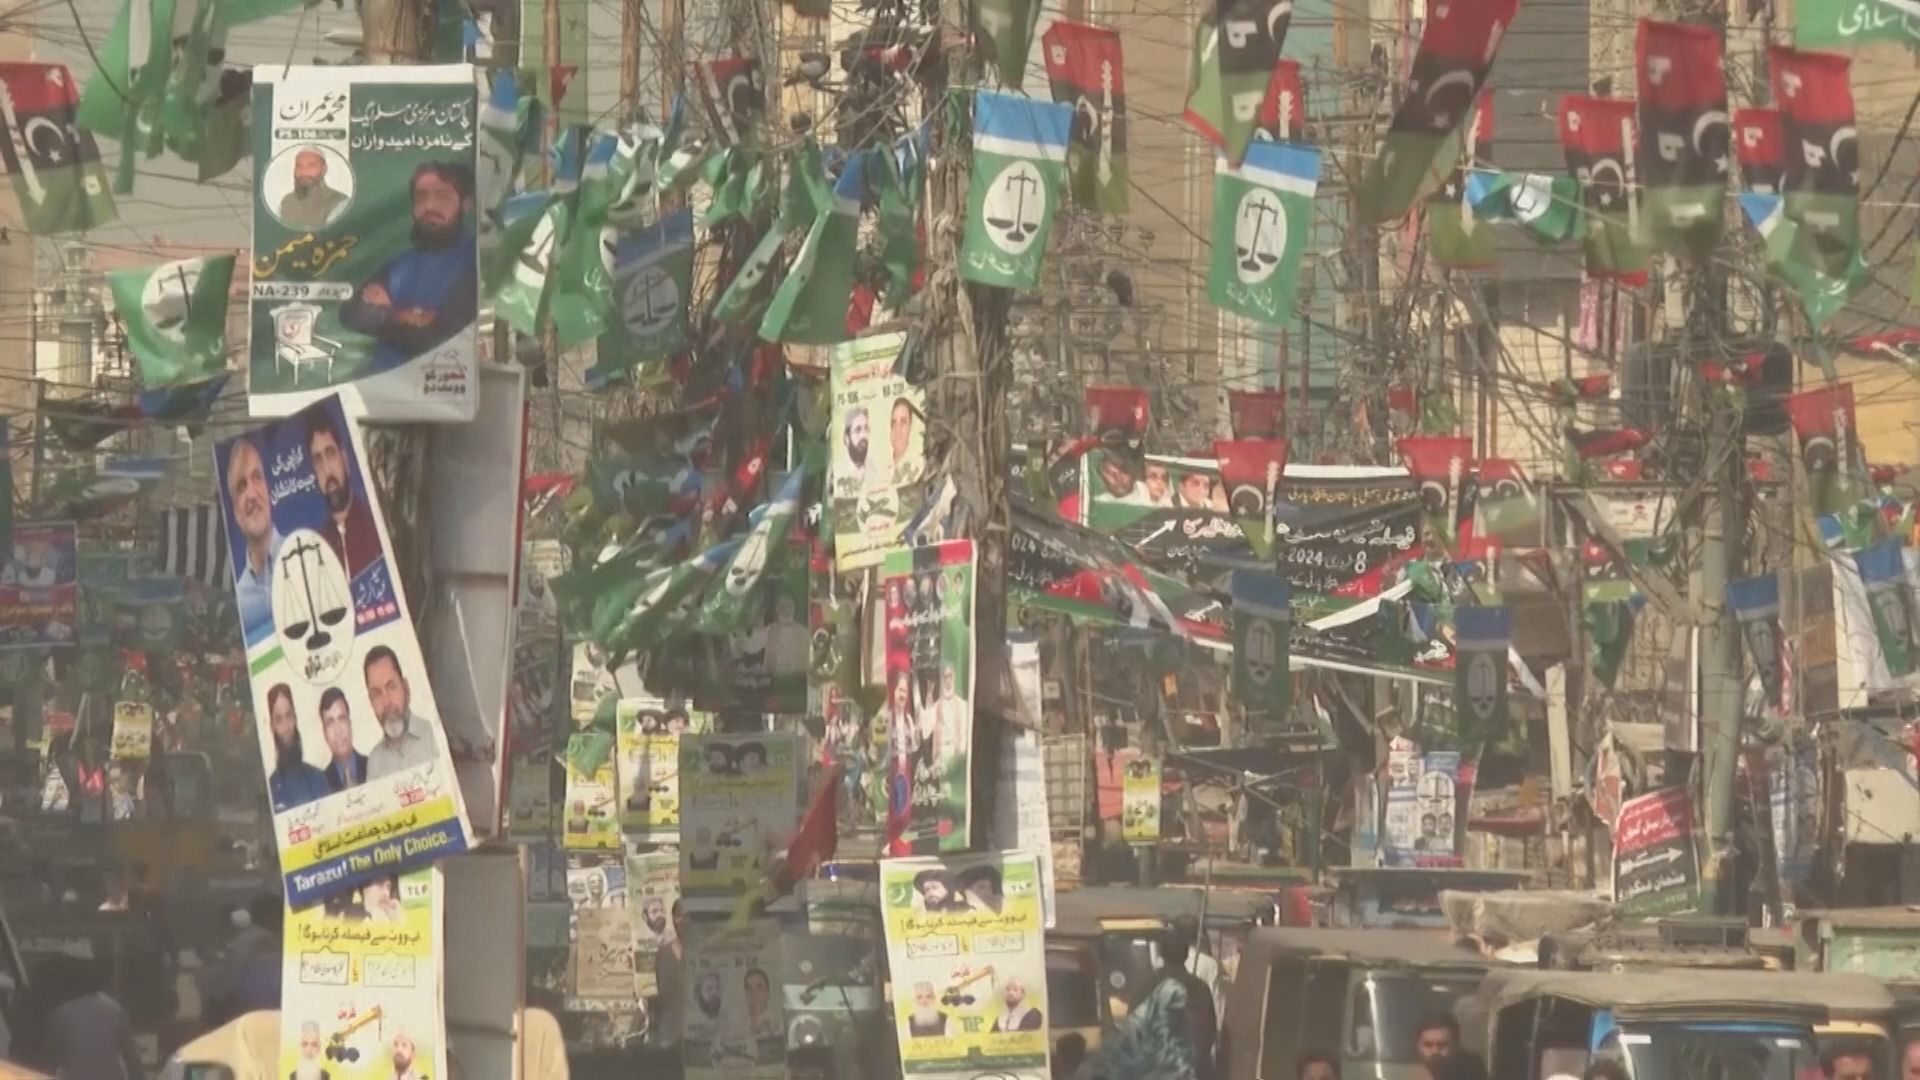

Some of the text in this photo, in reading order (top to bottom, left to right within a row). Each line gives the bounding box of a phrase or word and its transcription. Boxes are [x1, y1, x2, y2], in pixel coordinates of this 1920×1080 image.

[403, 100, 435, 126] مرکزی
[435, 97, 473, 128] پاکستان
[351, 134, 416, 151] امیدواران
[418, 134, 453, 150] نامزد
[451, 133, 473, 150] کے
[253, 285, 310, 297] NA-239
[1011, 533, 1037, 553] 024
[1287, 547, 1323, 567] 2024
[1354, 551, 1367, 574] 8
[293, 860, 348, 892] Tarazu!
[350, 853, 372, 873] The
[373, 845, 403, 865] Only
